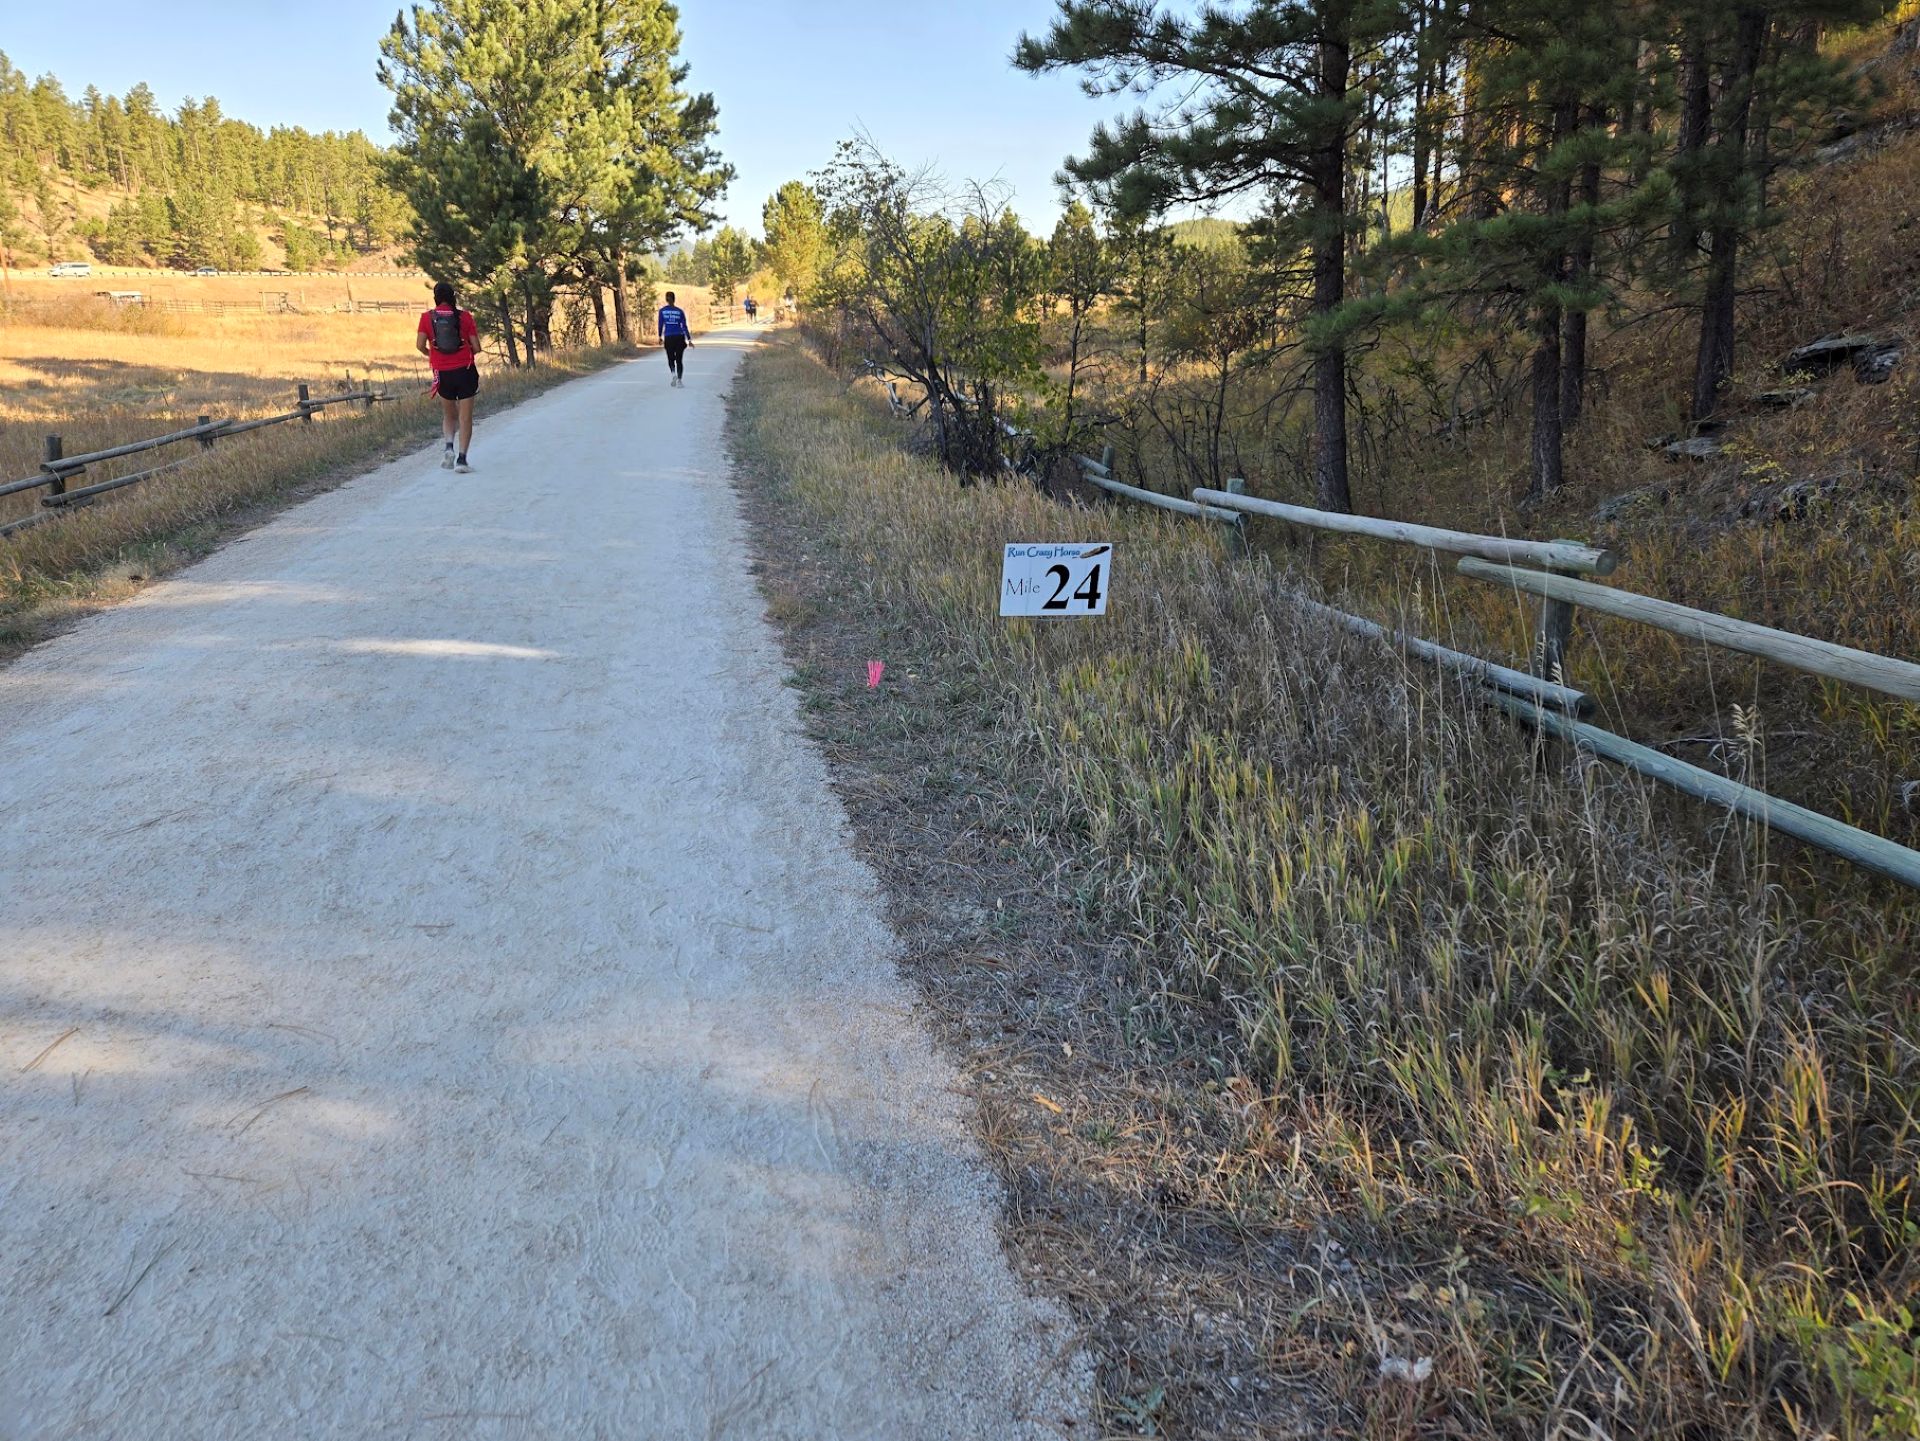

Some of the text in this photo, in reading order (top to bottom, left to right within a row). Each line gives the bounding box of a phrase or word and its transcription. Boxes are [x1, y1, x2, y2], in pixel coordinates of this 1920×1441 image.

[1007, 546, 1080, 559] Run Crazy Horse
[1006, 564, 1101, 609] Mile 24
